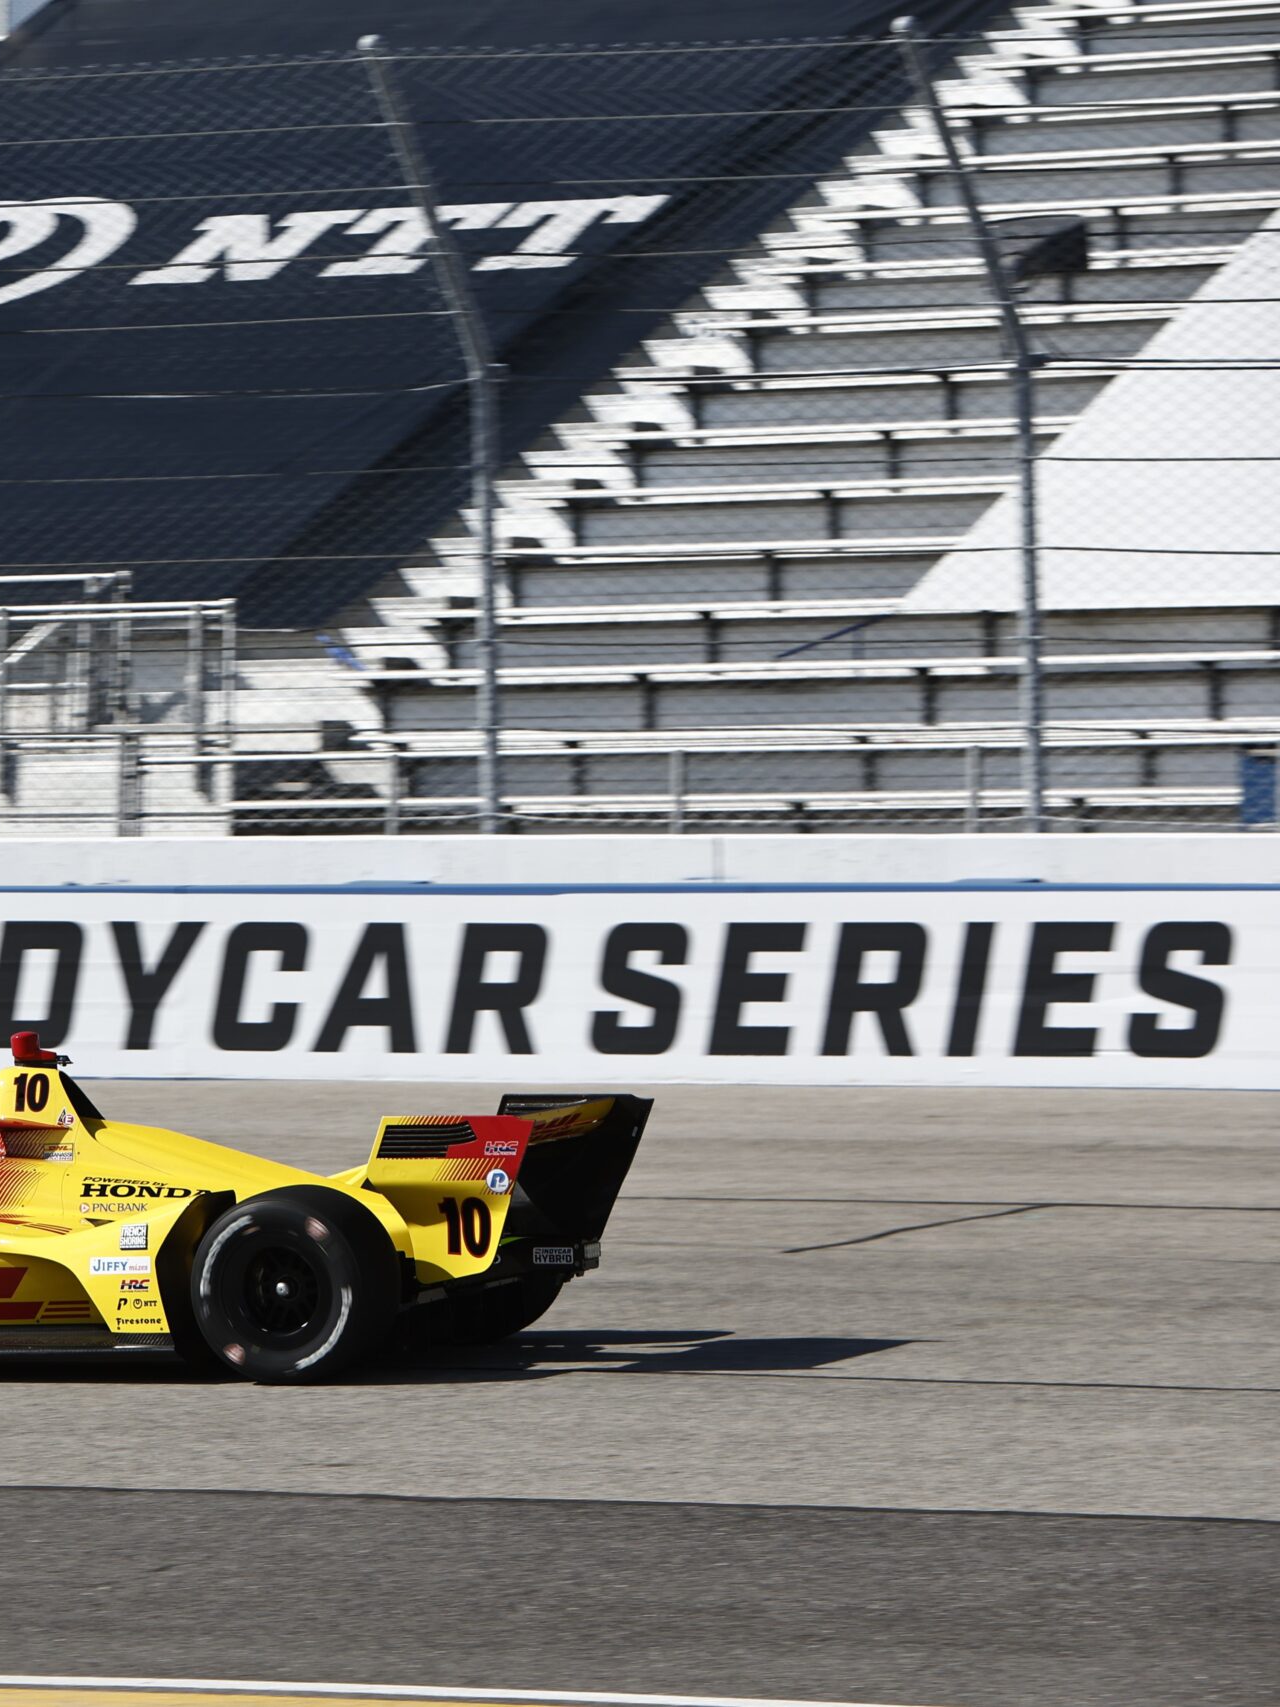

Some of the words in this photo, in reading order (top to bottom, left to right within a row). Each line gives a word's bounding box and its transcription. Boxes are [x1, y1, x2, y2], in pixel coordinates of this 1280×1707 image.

[129, 195, 671, 286] NTT
[591, 921, 1234, 1059] SERIES
[13, 1072, 51, 1113] 10
[485, 1140, 519, 1153] HRC
[83, 1176, 150, 1186] POWERED
[92, 1203, 117, 1213] PNC
[117, 1202, 148, 1212] BANK
[438, 1196, 492, 1259] 10
[534, 1255, 572, 1264] HYBRID
[120, 1279, 151, 1290] HRC
[116, 1317, 162, 1326] Firestone
